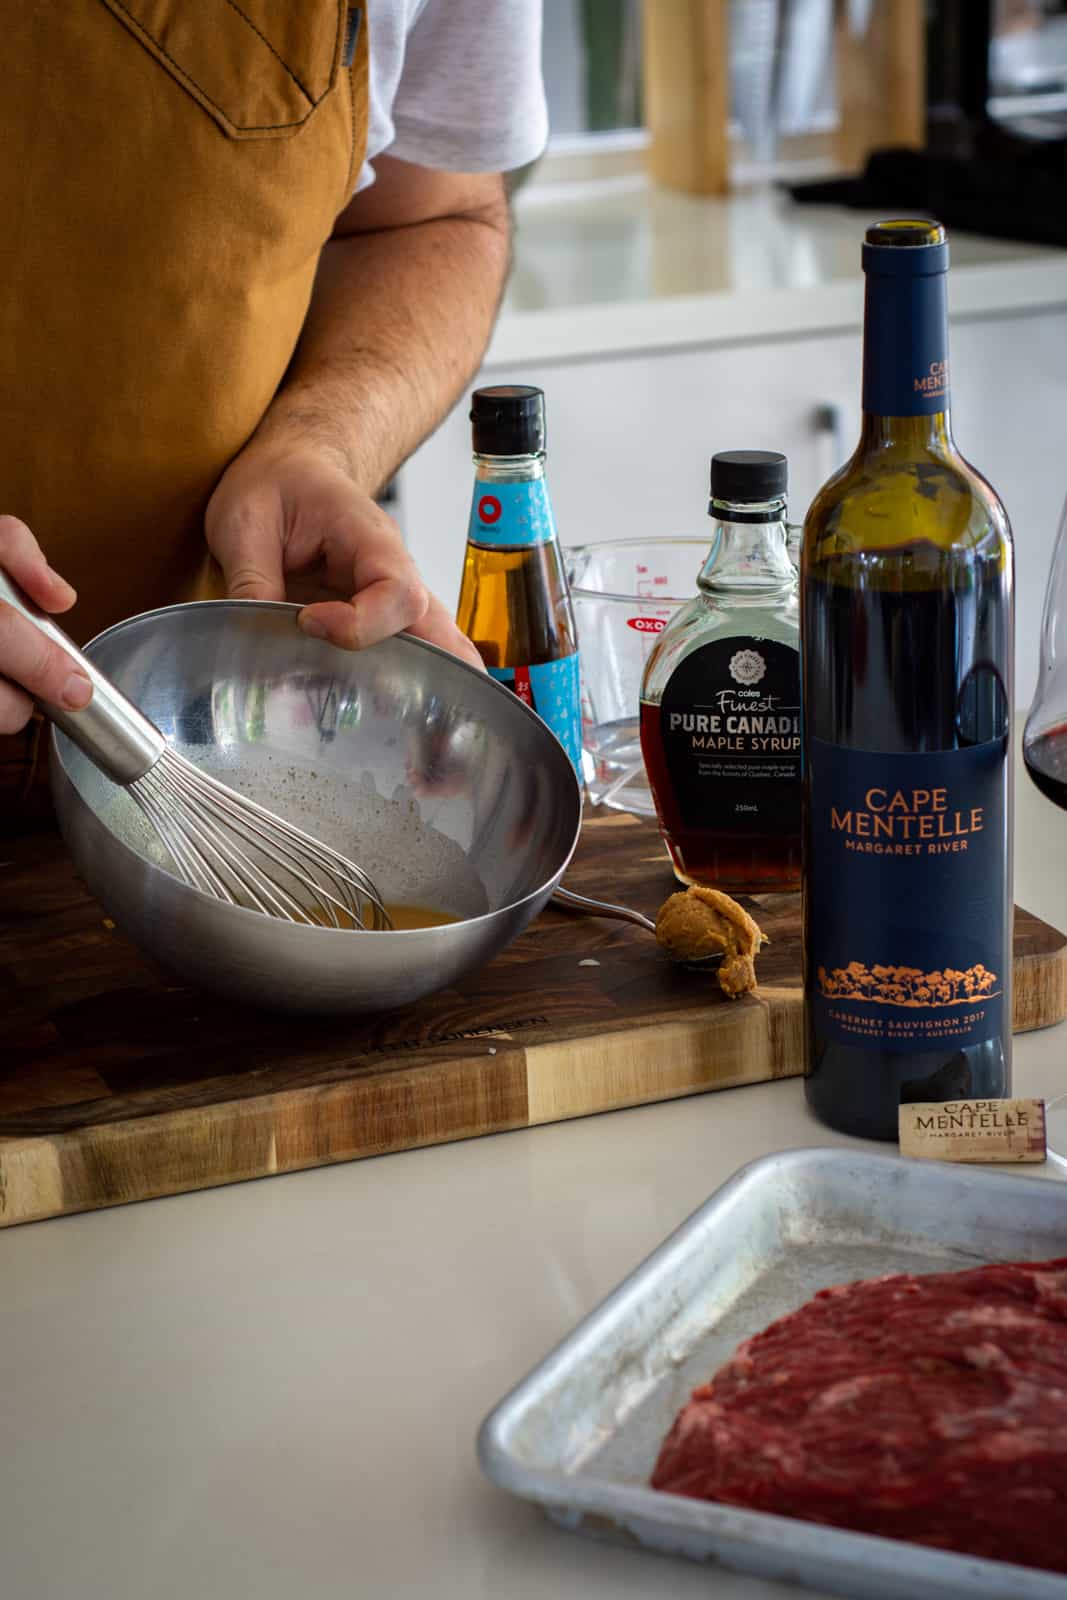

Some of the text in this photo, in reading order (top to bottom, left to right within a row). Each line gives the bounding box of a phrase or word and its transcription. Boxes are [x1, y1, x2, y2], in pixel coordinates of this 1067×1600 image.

[635, 619, 664, 630] OXO
[715, 690, 780, 714] Finest
[670, 713, 721, 732] PURE
[692, 736, 801, 751] MAPLE SYRUP
[865, 788, 948, 812] CAPE
[831, 808, 985, 839] MENTELLE
[845, 839, 968, 855] MARGARET RIVER
[888, 1018, 960, 1030] SAUVIGNON
[963, 1011, 985, 1024] 2017
[943, 1102, 999, 1114] CAPE
[915, 1112, 1029, 1130] MENTELLE
